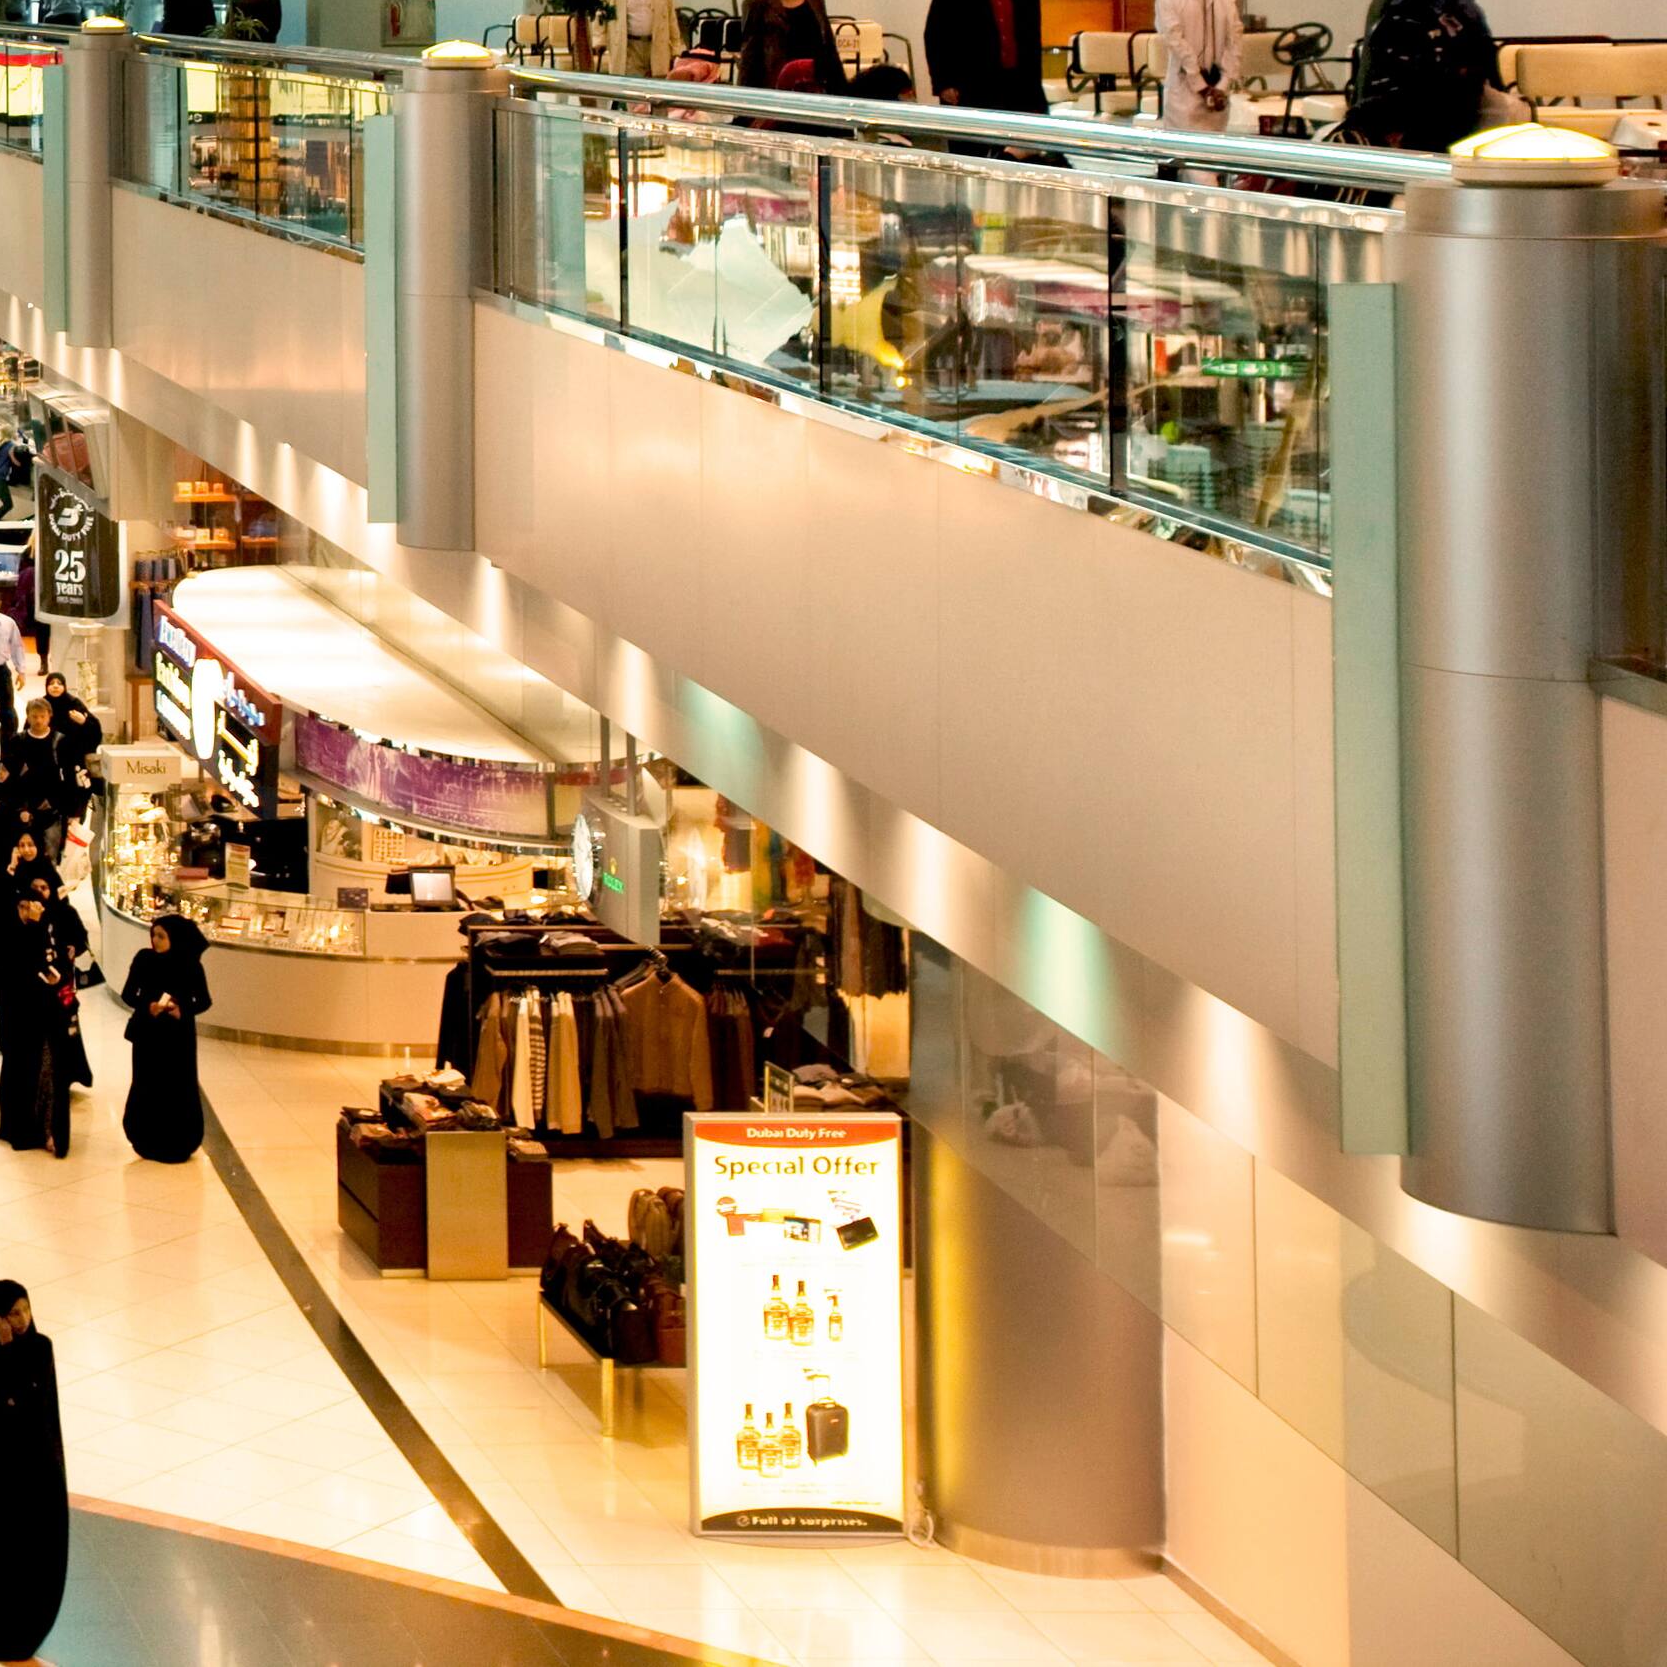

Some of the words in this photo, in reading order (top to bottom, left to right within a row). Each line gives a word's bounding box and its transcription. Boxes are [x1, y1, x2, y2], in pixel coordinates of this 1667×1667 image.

[61, 533, 82, 542] DUTY
[54, 549, 86, 583] 25
[55, 581, 84, 596] years
[125, 758, 167, 775] Misaki
[746, 1127, 784, 1138] Dubai
[785, 1127, 816, 1140] Duty
[818, 1127, 847, 1138] Free
[714, 1155, 804, 1181] Special
[812, 1155, 880, 1175] Offer
[751, 1515, 778, 1526] Full
[781, 1516, 796, 1526] of
[799, 1517, 869, 1529] surprises.
